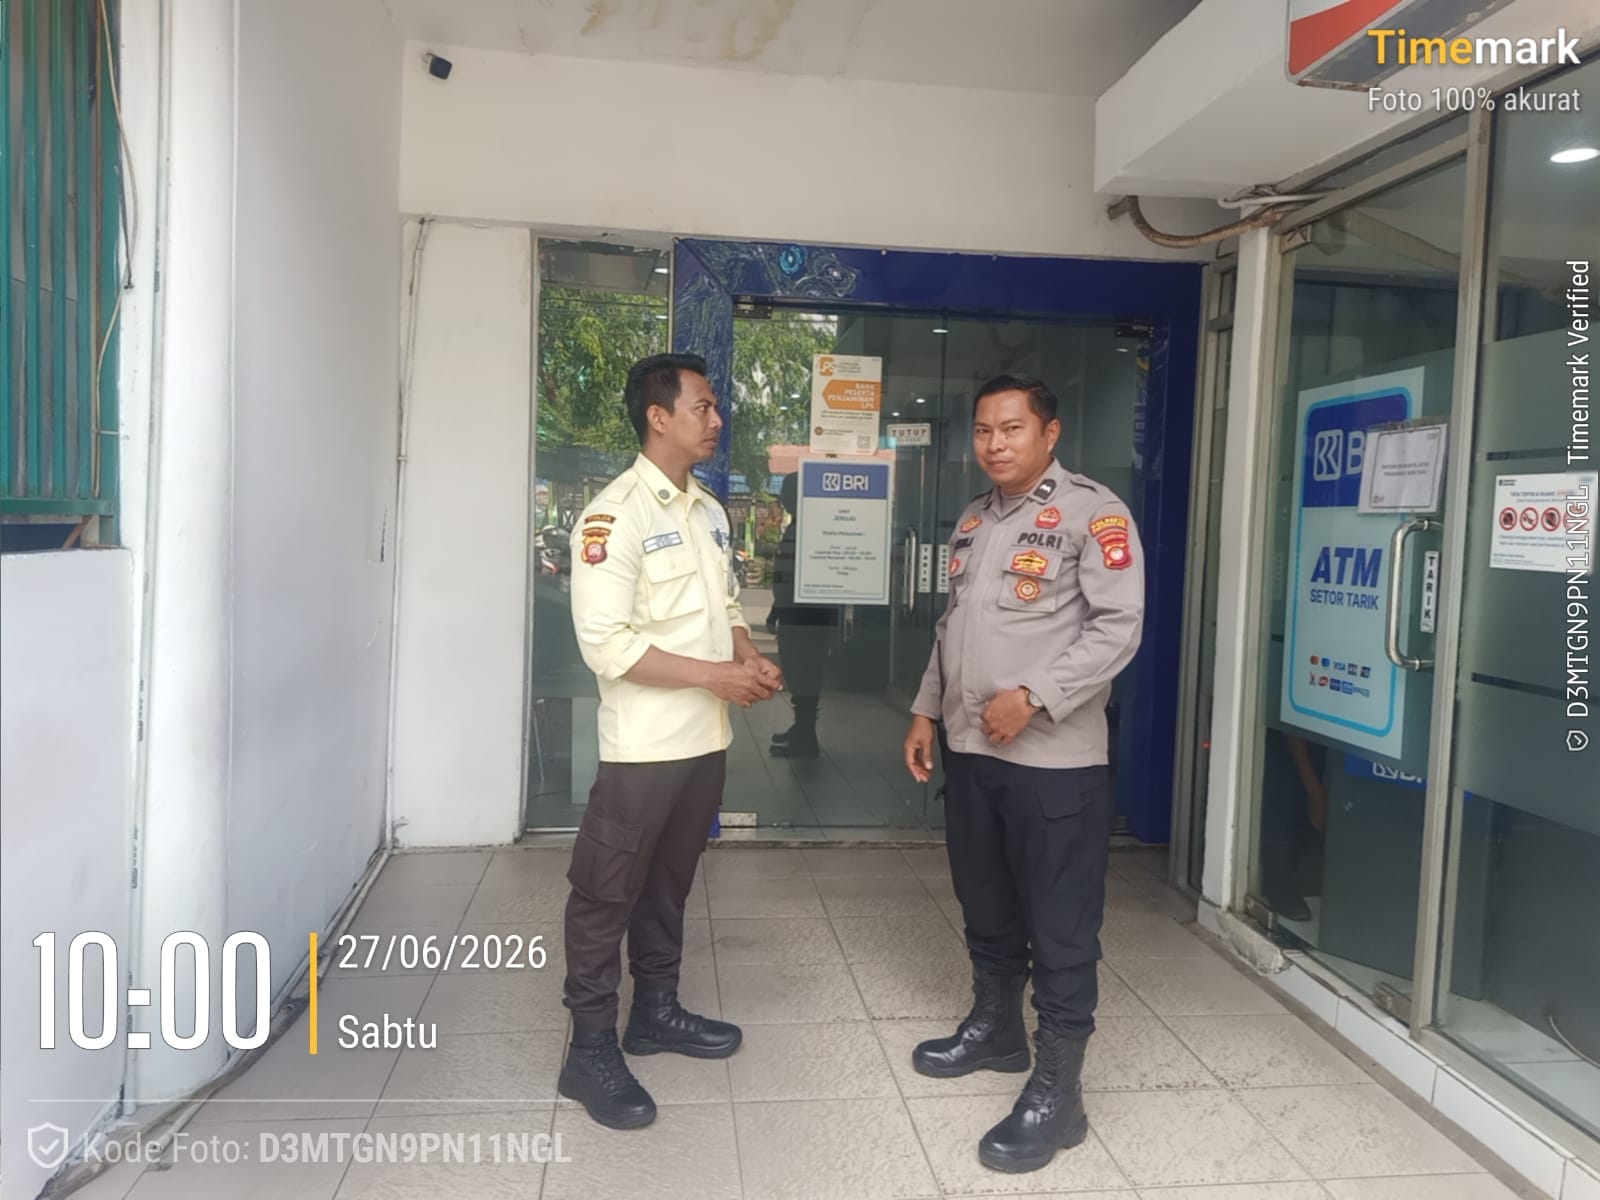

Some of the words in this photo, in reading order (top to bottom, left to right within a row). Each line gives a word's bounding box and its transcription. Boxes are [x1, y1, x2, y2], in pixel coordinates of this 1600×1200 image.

[842, 475, 869, 491] BRI
[1017, 532, 1063, 550] POLRI
[1310, 546, 1383, 588] ATM
[1424, 556, 1435, 619] TARIK
[1310, 589, 1344, 606] SETOR
[1346, 592, 1379, 610] TARIK
